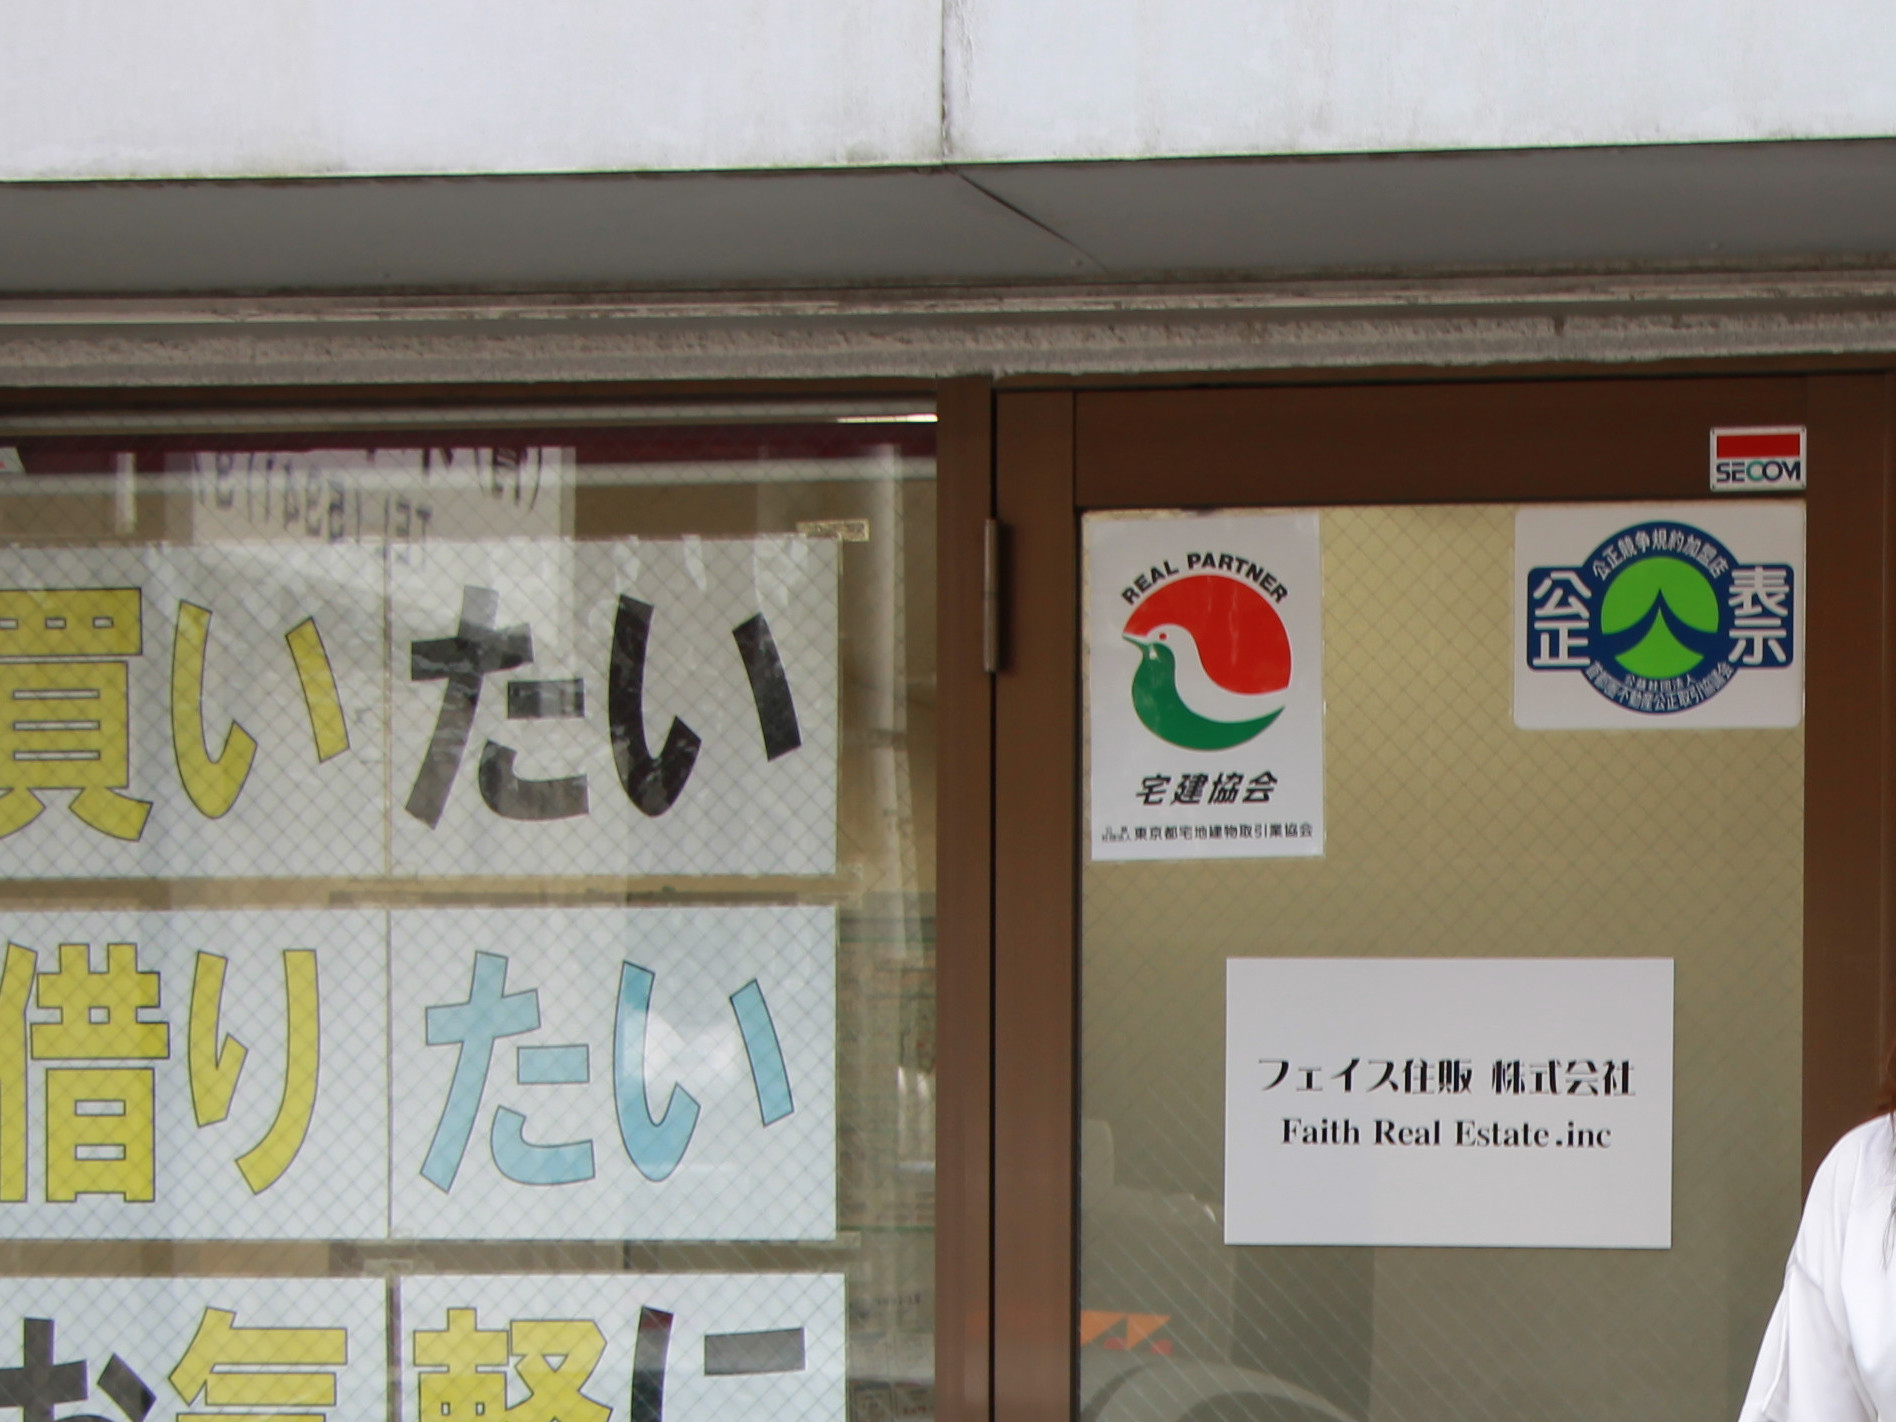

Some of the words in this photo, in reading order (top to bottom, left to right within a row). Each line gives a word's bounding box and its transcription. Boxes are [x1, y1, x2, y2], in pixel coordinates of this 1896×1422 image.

[1715, 460, 1801, 483] SECOM
[1121, 560, 1179, 605] REAL
[1187, 552, 1289, 603] PARTNER
[1533, 569, 1593, 667] 公正
[1727, 565, 1790, 666] 表示
[1135, 771, 1278, 806] 宅建協会
[1257, 1056, 1473, 1094] フェイス住販
[1490, 1058, 1637, 1097] 株式会社
[1281, 1117, 1361, 1146] Faith
[1372, 1118, 1441, 1147] Real
